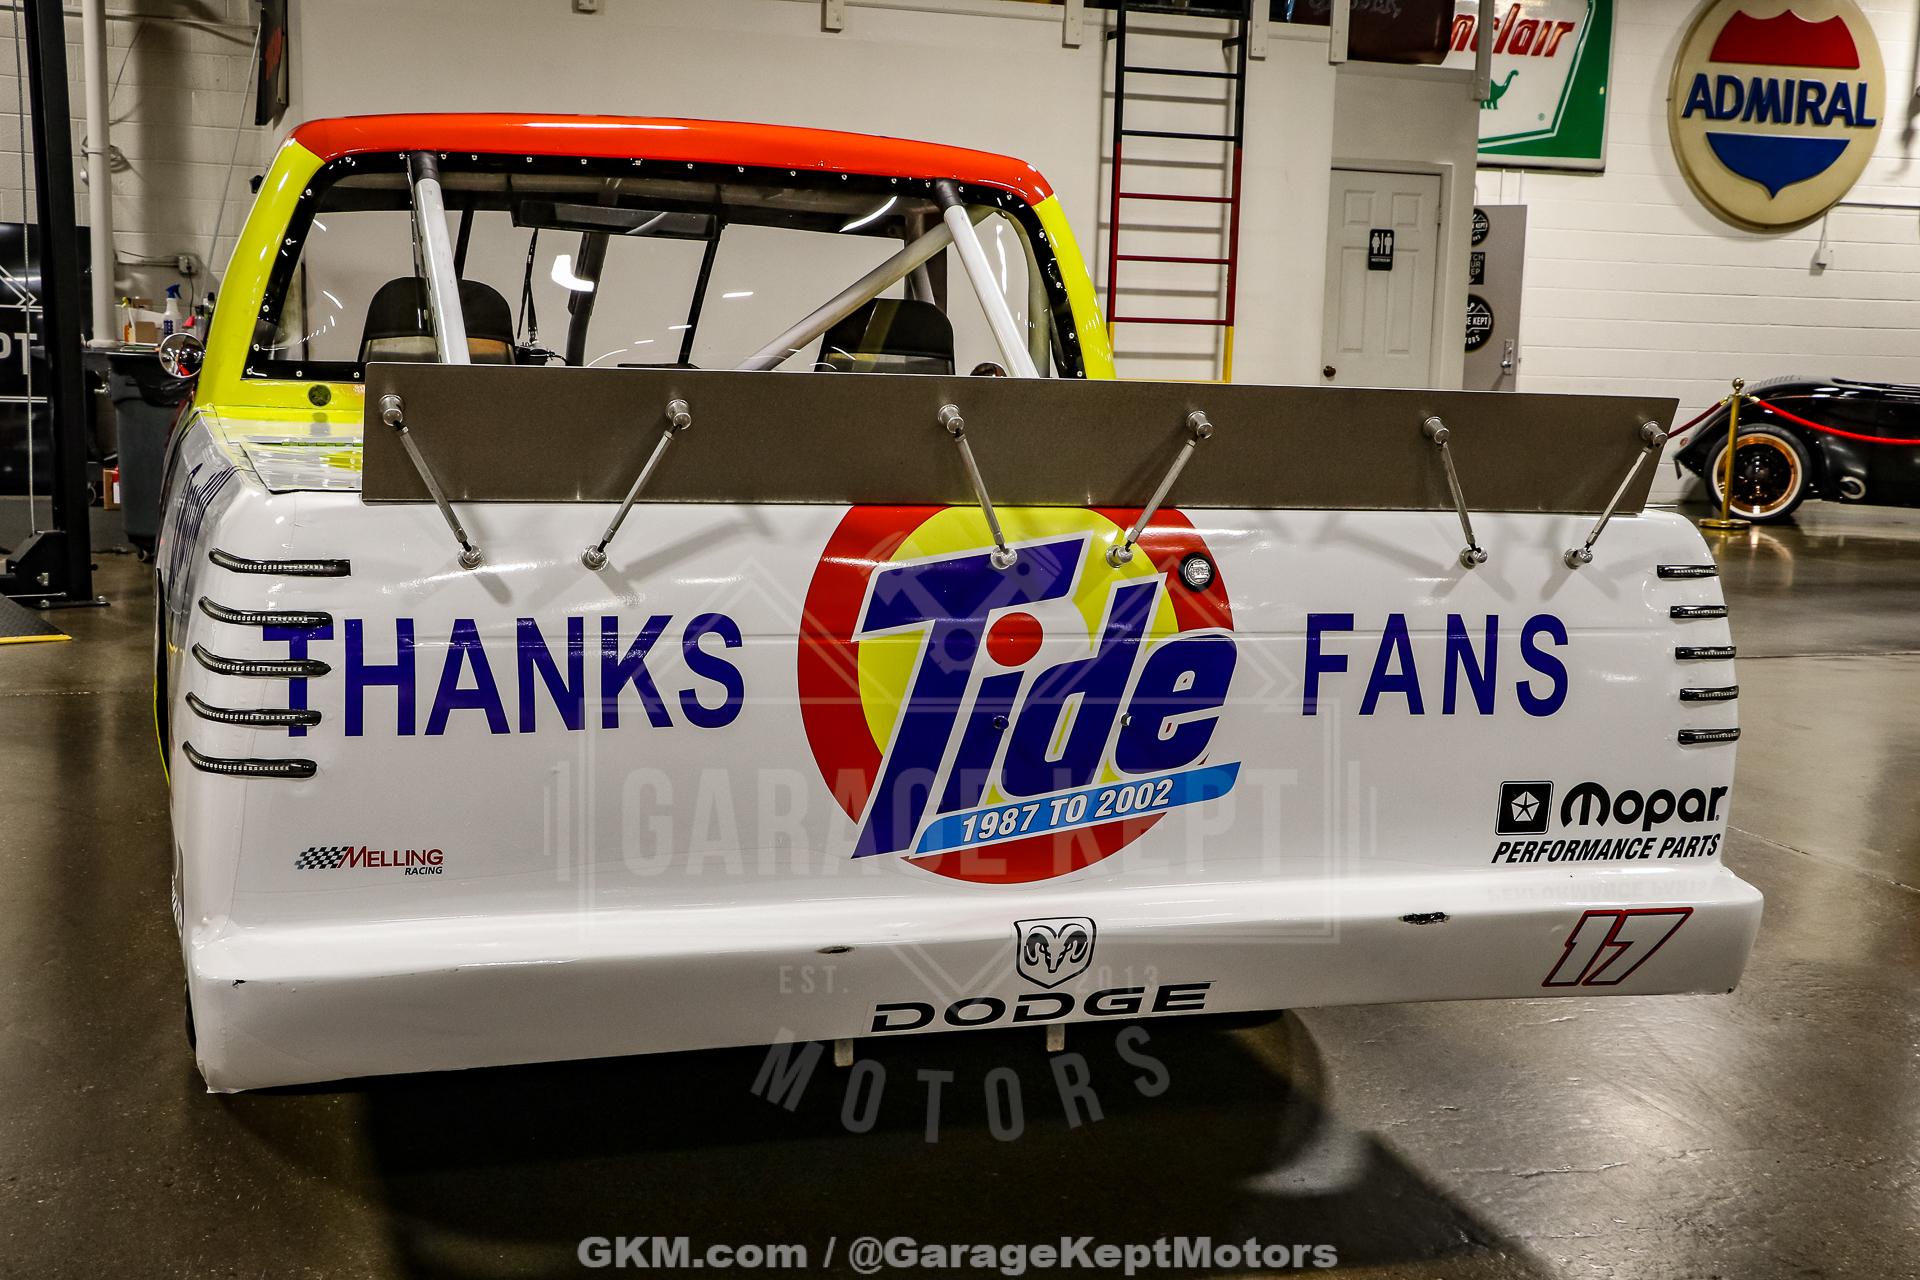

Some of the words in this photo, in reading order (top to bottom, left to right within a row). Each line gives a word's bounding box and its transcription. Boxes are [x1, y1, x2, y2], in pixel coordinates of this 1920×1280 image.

[1451, 3, 1576, 57] nclair
[1681, 73, 1877, 128] ADMIRAL
[1472, 316, 1488, 325] KEPT
[262, 612, 745, 738] THANKS
[1302, 613, 1570, 717] FANS
[850, 530, 1239, 859] Tide
[962, 804, 1040, 843] 1987
[1049, 796, 1087, 829] TO
[1096, 777, 1174, 819] 2002
[1560, 781, 1728, 831] Mopar
[337, 846, 443, 868] MELLING
[404, 866, 443, 876] RACING
[1491, 837, 1657, 864] PERFORMANCE
[1657, 833, 1721, 859] PARTS
[1541, 907, 1694, 987] 17
[871, 981, 1213, 1033] DODGE
